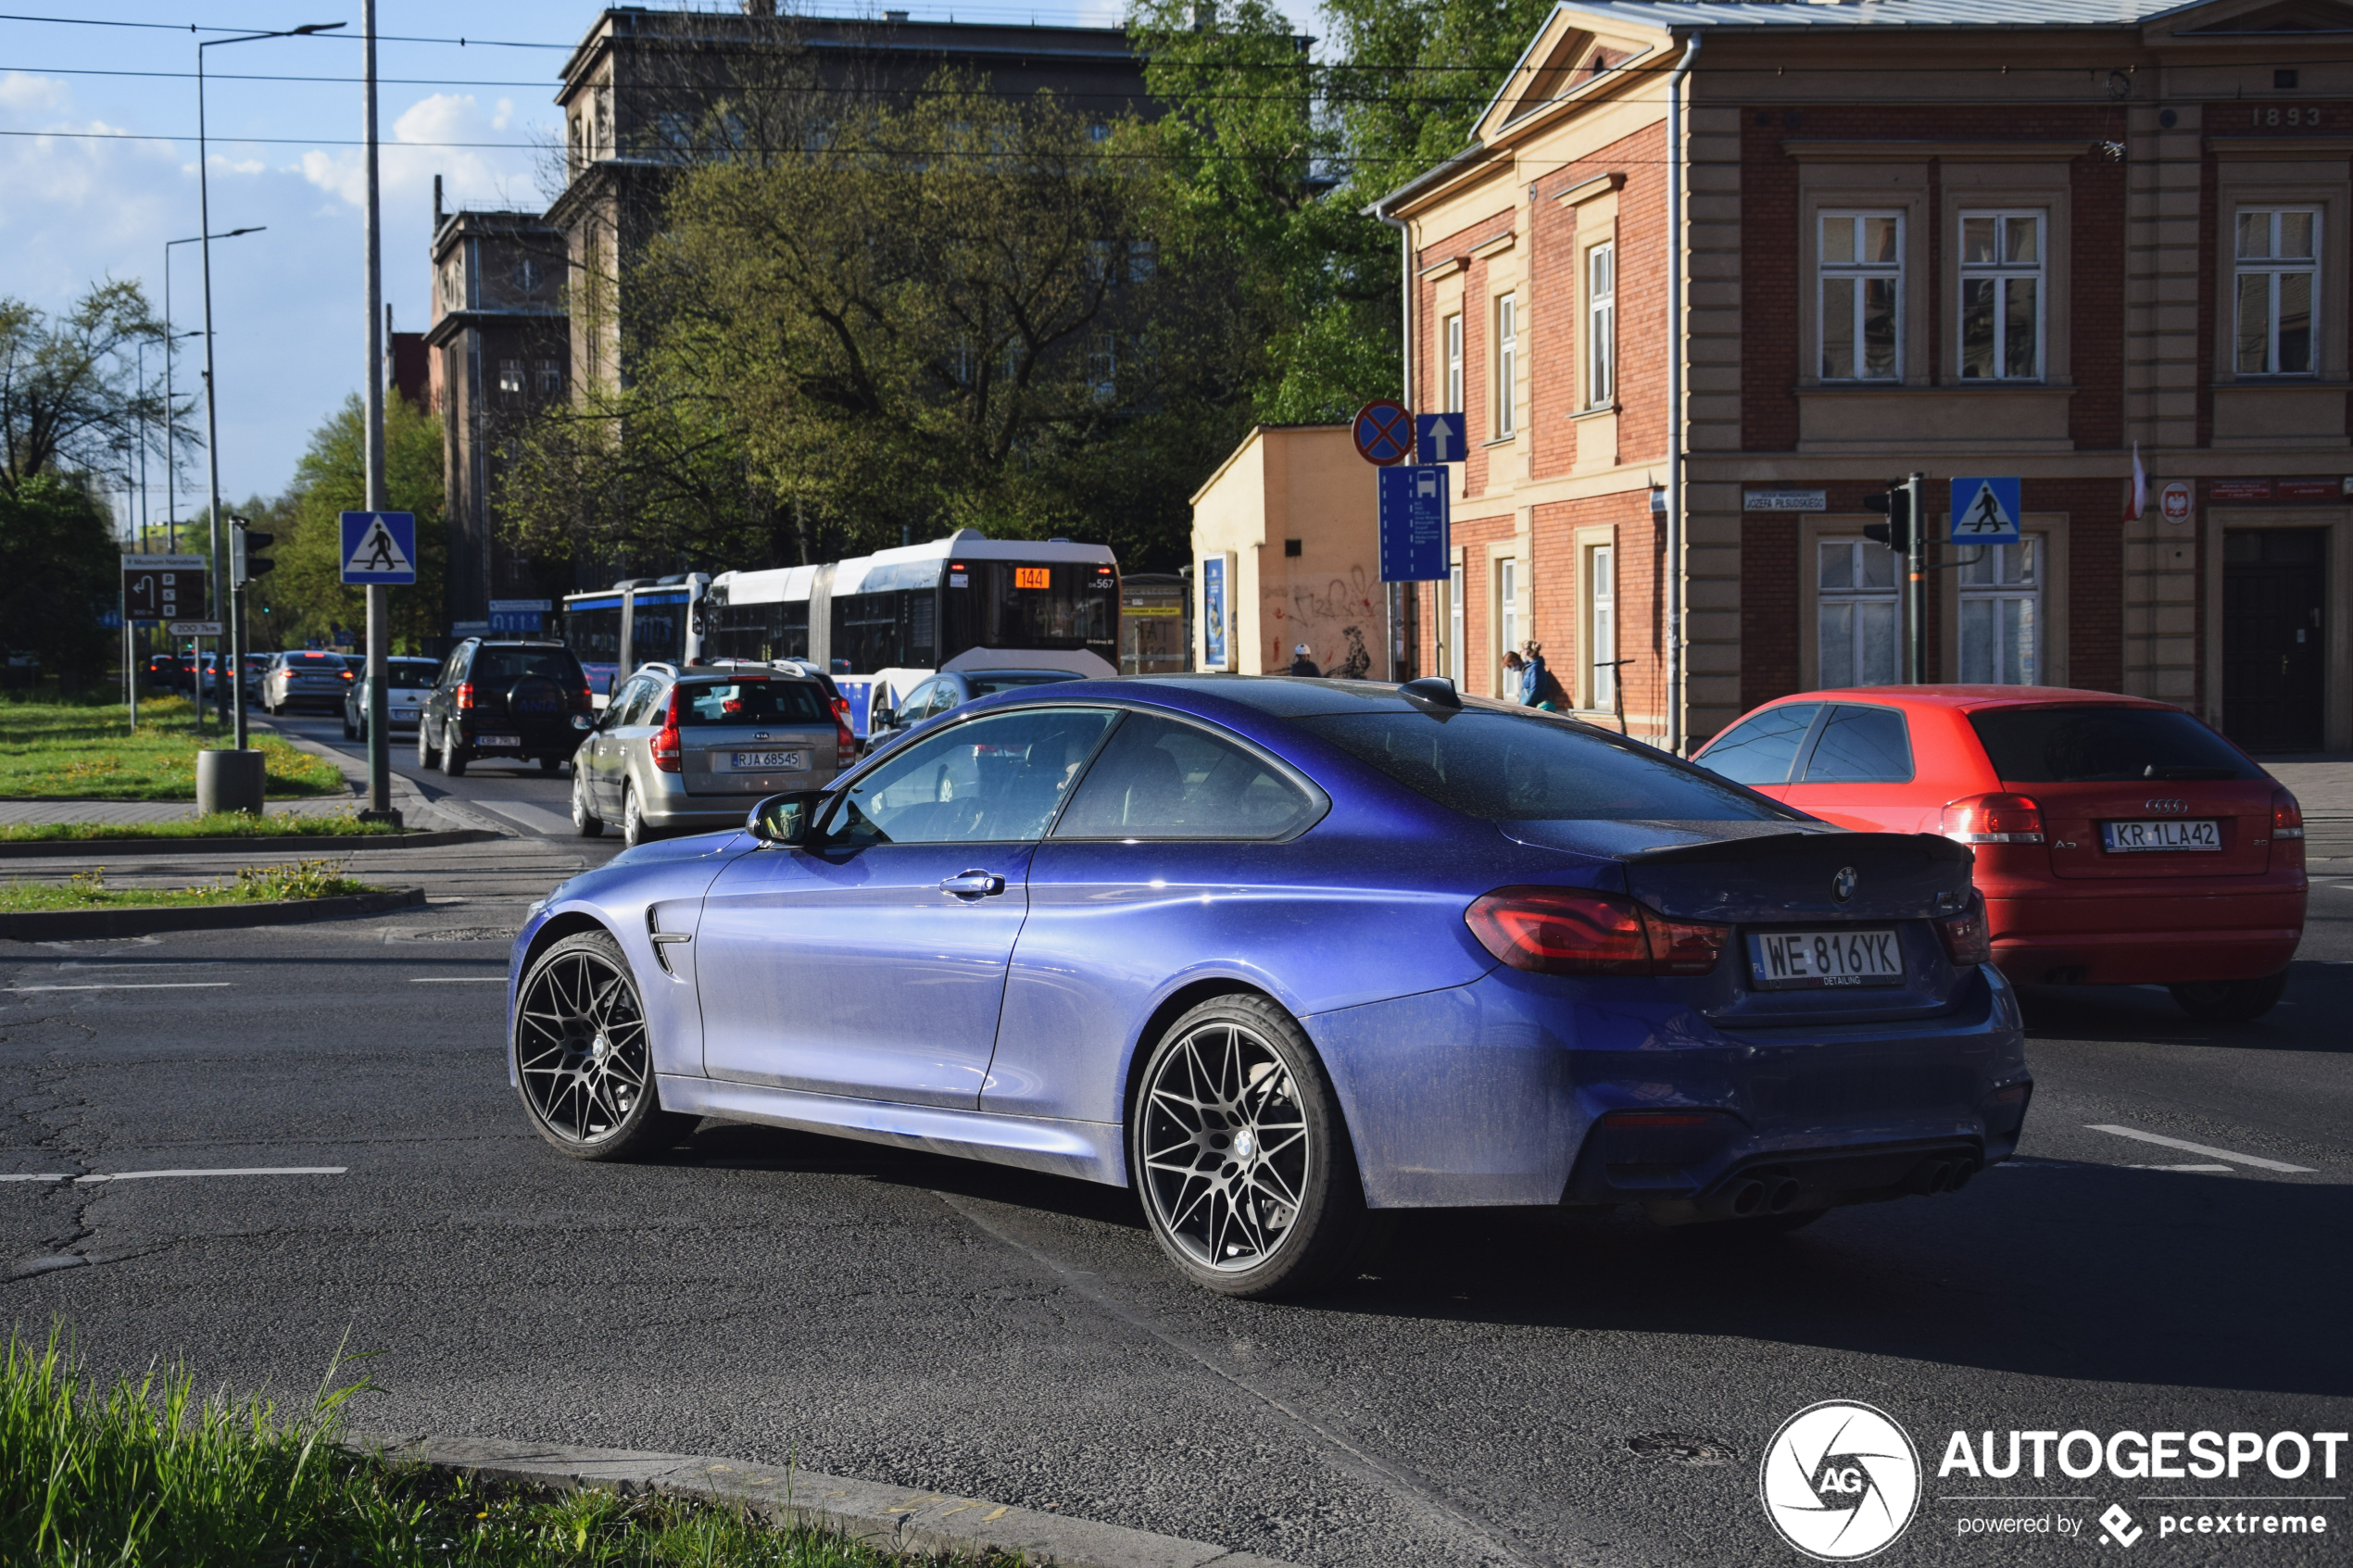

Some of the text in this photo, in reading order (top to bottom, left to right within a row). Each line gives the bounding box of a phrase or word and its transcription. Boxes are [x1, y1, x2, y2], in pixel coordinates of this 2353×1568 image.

[2252, 107, 2320, 126] 1893
[1021, 569, 1043, 587] 144
[518, 699, 558, 712] ANIA
[738, 752, 799, 766] RJA 68545
[2117, 823, 2215, 846] KR 1LA42
[2054, 839, 2077, 849] A3
[1767, 935, 1896, 976] WE 816YK
[1753, 962, 1764, 972] PL
[1823, 975, 1861, 985] DETAILING
